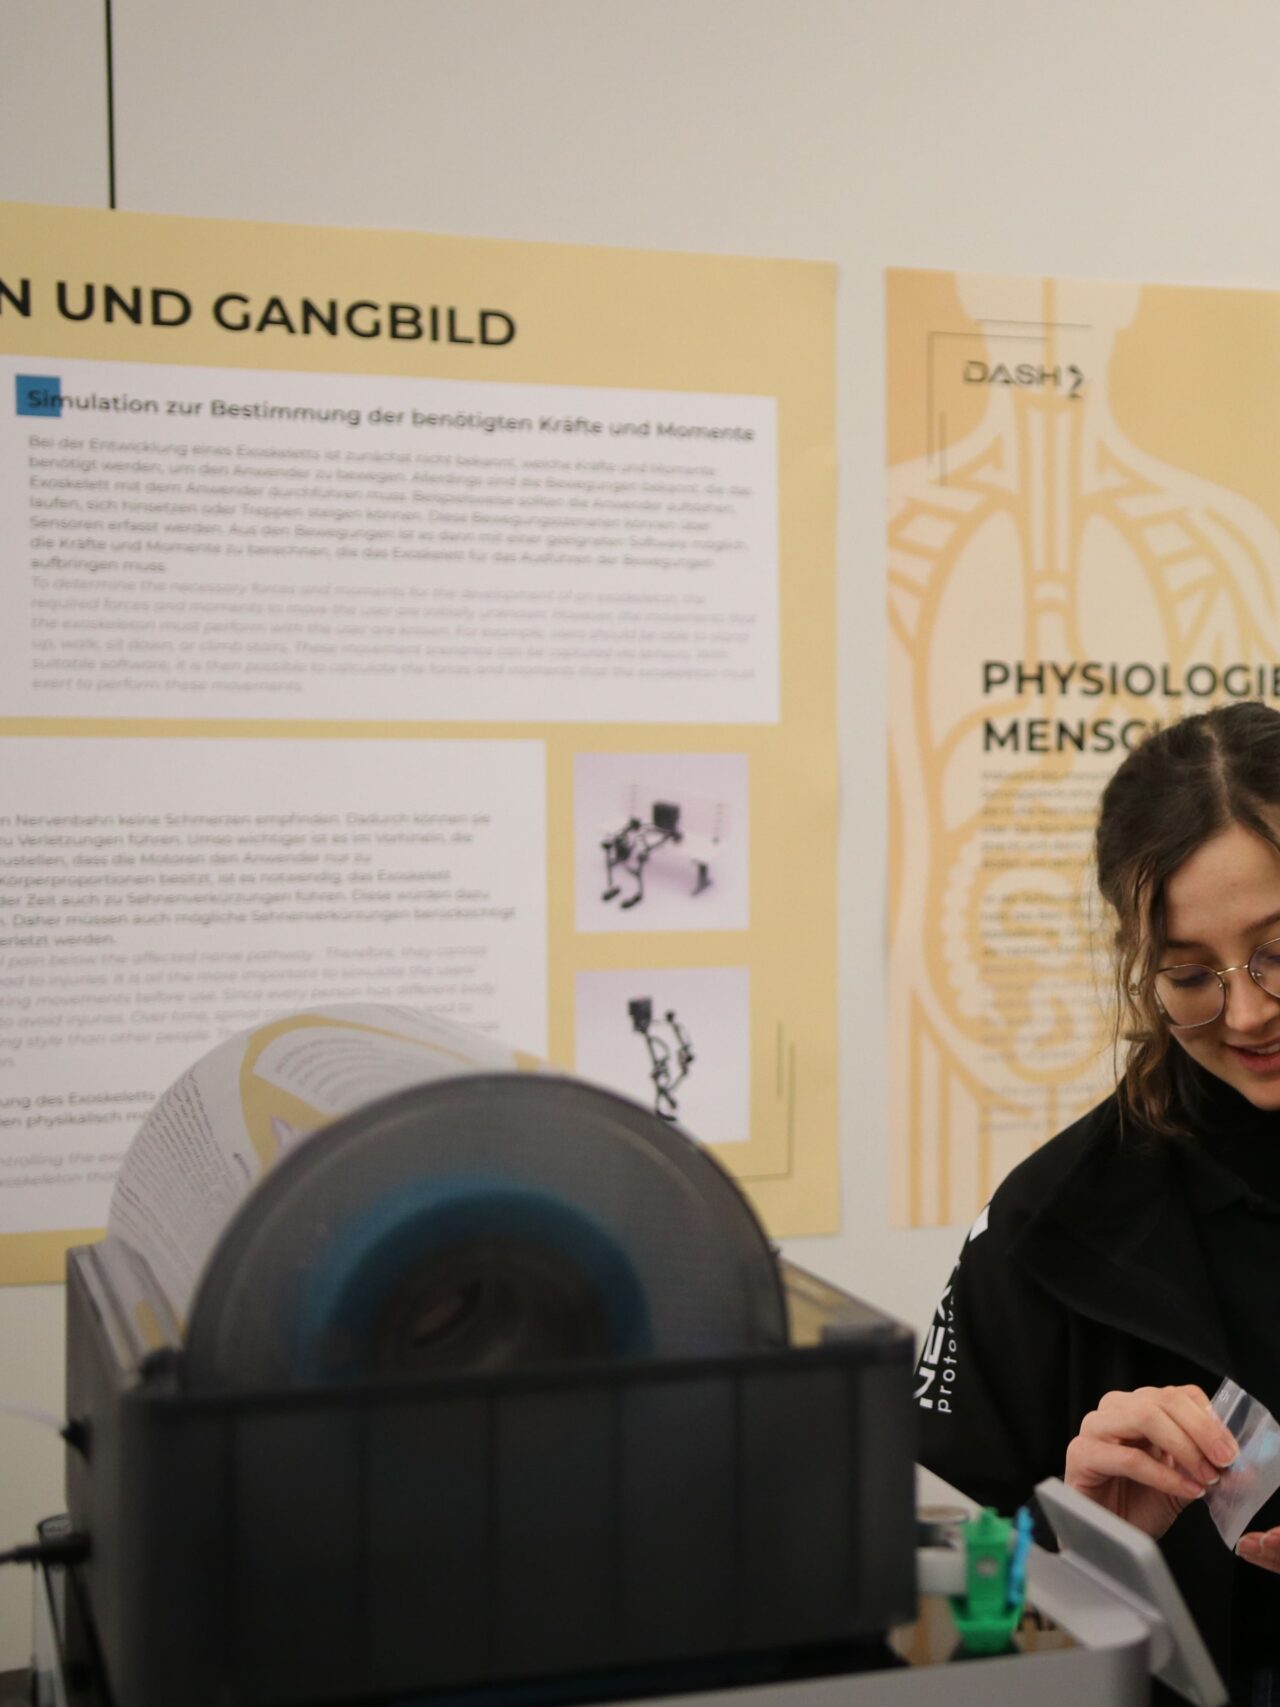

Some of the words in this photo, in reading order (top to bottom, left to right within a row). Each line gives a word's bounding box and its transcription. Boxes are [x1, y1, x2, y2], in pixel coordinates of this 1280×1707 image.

[57, 281, 192, 326] UND
[213, 292, 516, 346] GANGBILD
[963, 360, 1060, 386] DASH
[27, 388, 157, 415] Simulation
[166, 401, 204, 416] zur
[211, 399, 361, 426] Bestimmung
[367, 405, 405, 425] der
[411, 407, 532, 434] benötigten
[539, 415, 603, 434] Kräfte
[608, 418, 651, 437] und
[656, 421, 756, 442] Momente
